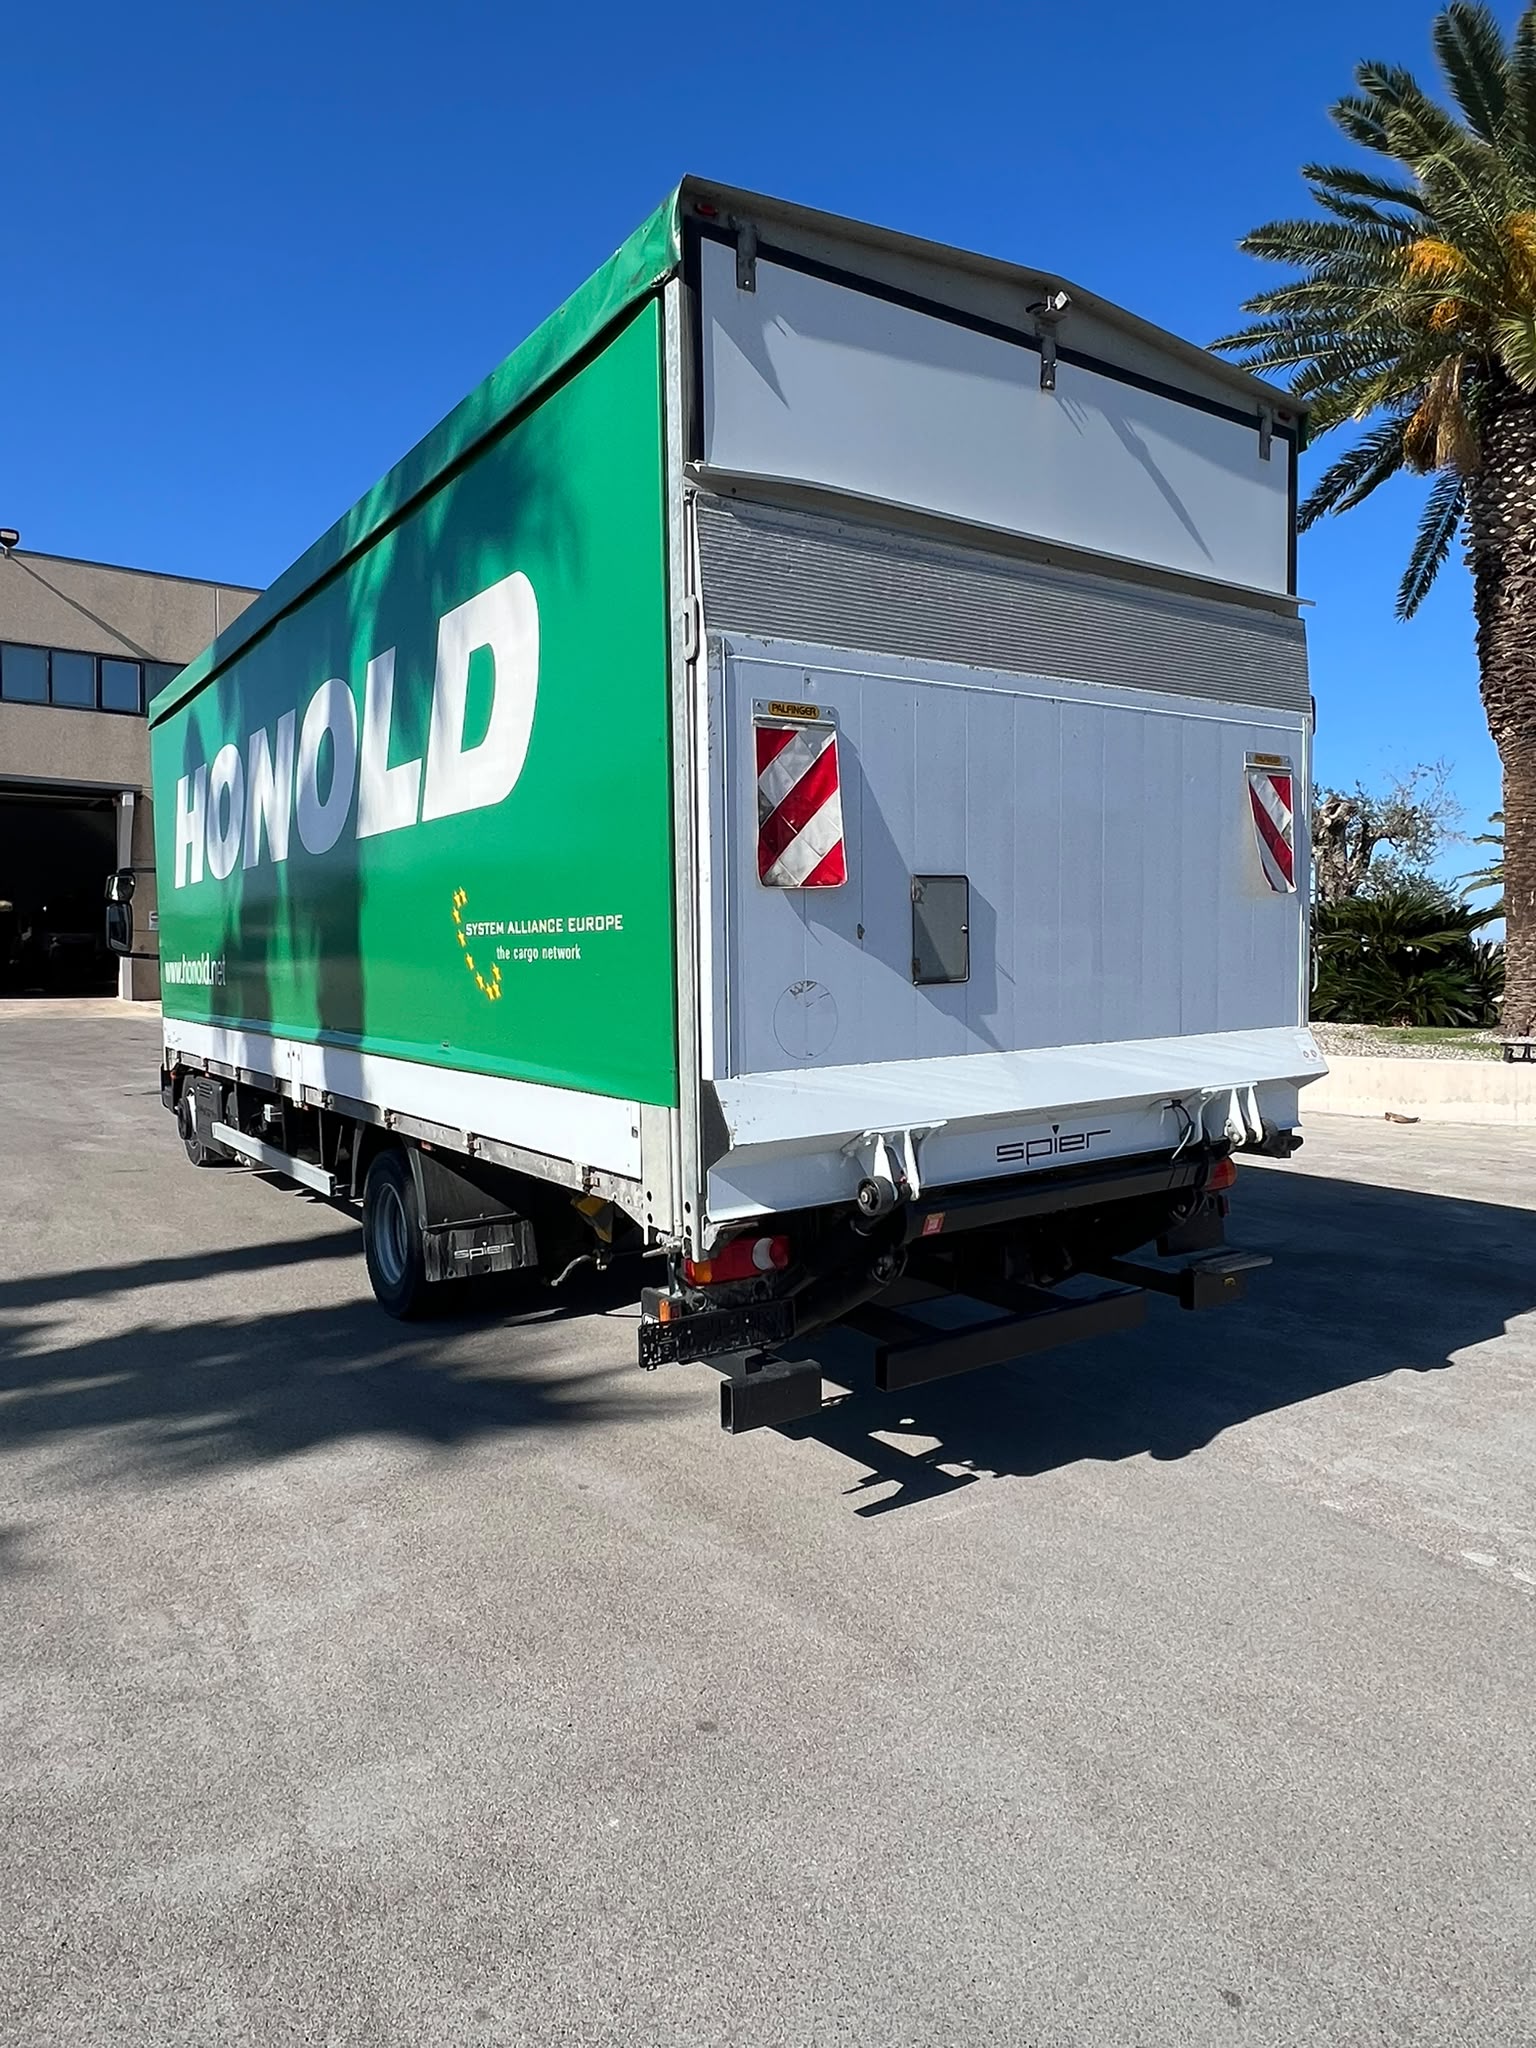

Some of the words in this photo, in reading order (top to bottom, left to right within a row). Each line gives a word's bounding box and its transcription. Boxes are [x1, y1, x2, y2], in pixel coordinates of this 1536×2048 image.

[771, 703, 817, 716] PALFINGER
[175, 570, 540, 889] HONOLD
[465, 921, 504, 936] SYSTEM
[507, 918, 563, 934] ALLIANCE
[567, 914, 623, 932] EUROPE
[496, 945, 510, 960] the
[513, 949, 539, 963] cargo
[542, 944, 581, 960] network
[164, 952, 226, 986] www.honold.net
[996, 1124, 1111, 1165] spier
[454, 1241, 515, 1260] spier
